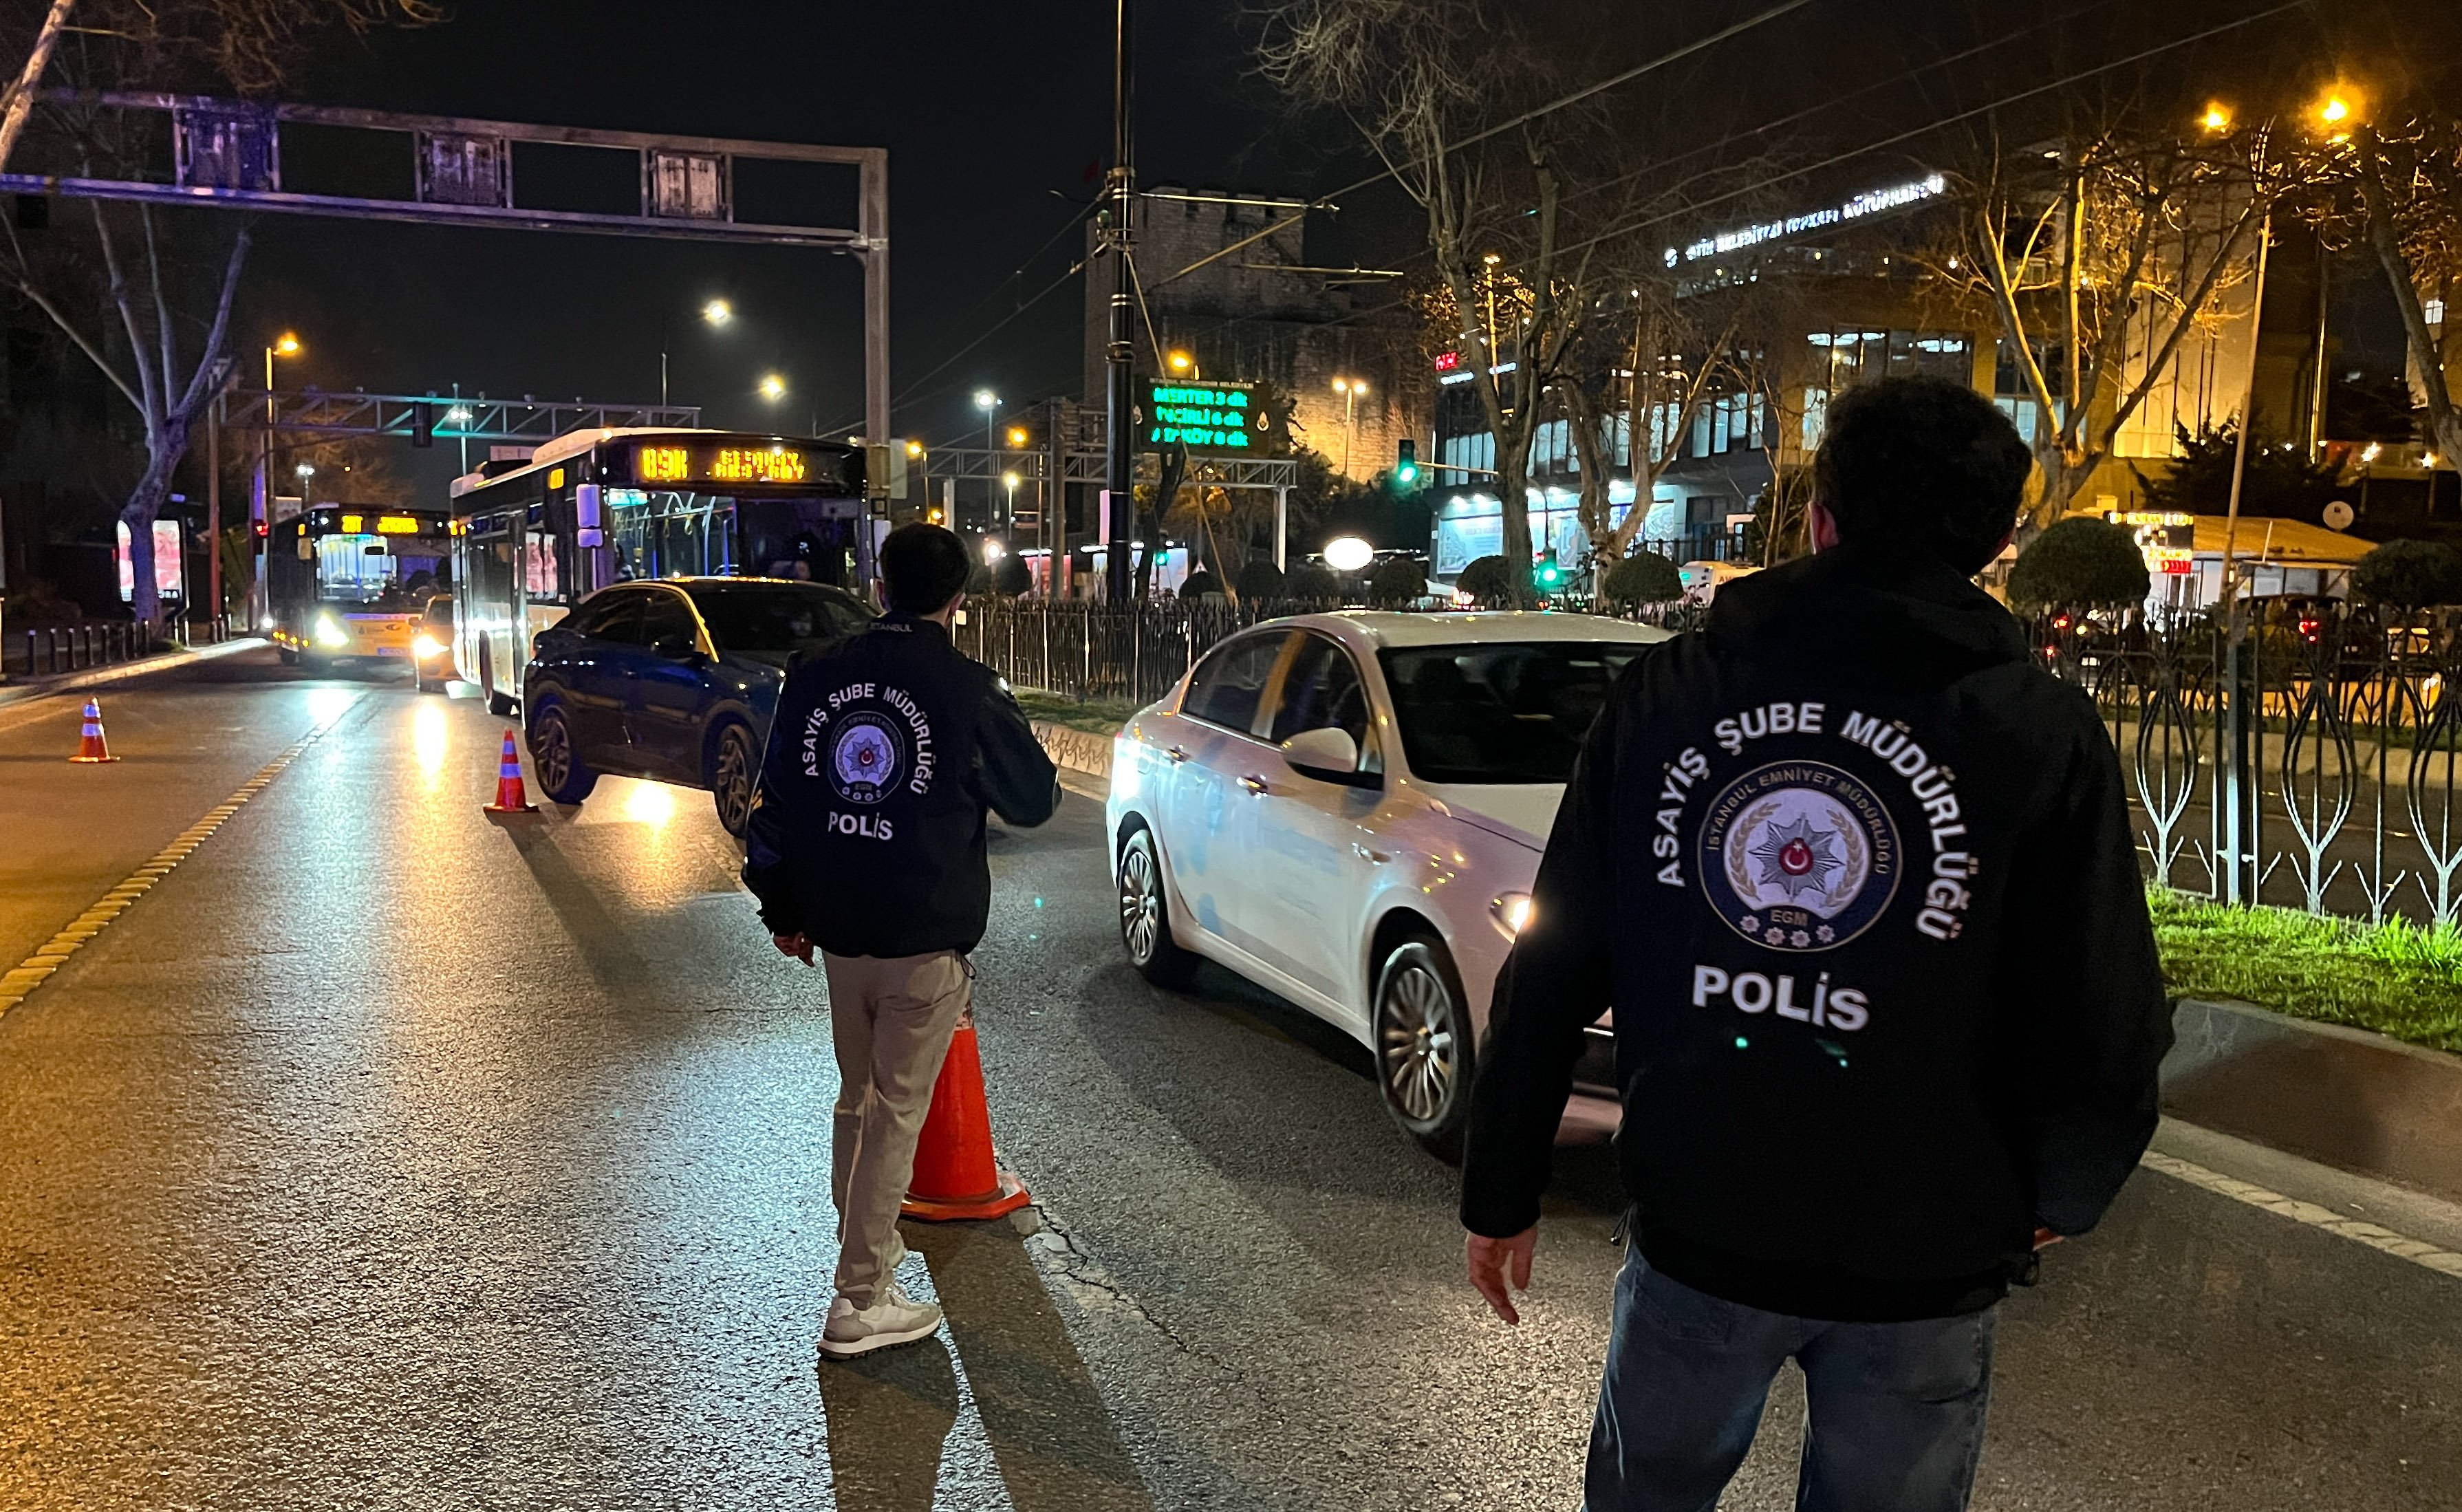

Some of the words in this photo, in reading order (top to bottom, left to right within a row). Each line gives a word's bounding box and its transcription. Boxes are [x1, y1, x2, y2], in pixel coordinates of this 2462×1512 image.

[1154, 387, 1214, 405] MERTER
[1215, 391, 1227, 406] 3
[1227, 391, 1248, 407] dk
[1223, 411, 1244, 426] dk
[1227, 431, 1249, 446] dk
[802, 708, 830, 777] ASAYİŞ
[828, 683, 876, 711] ŞUBE
[883, 687, 936, 794] MÜDÜRLÜĞÜ
[1653, 746, 1711, 887] ASAYİŞ
[1714, 702, 1825, 756] ŞUBE
[1839, 710, 1979, 940] MÜDÜRLÜĞÜ
[1706, 784, 1758, 851] İSTANBUL
[1758, 767, 1836, 788] EMNİYET
[828, 811, 893, 841] POLİS
[1770, 909, 1809, 927] EGM
[1692, 964, 1870, 1030] POLİS
